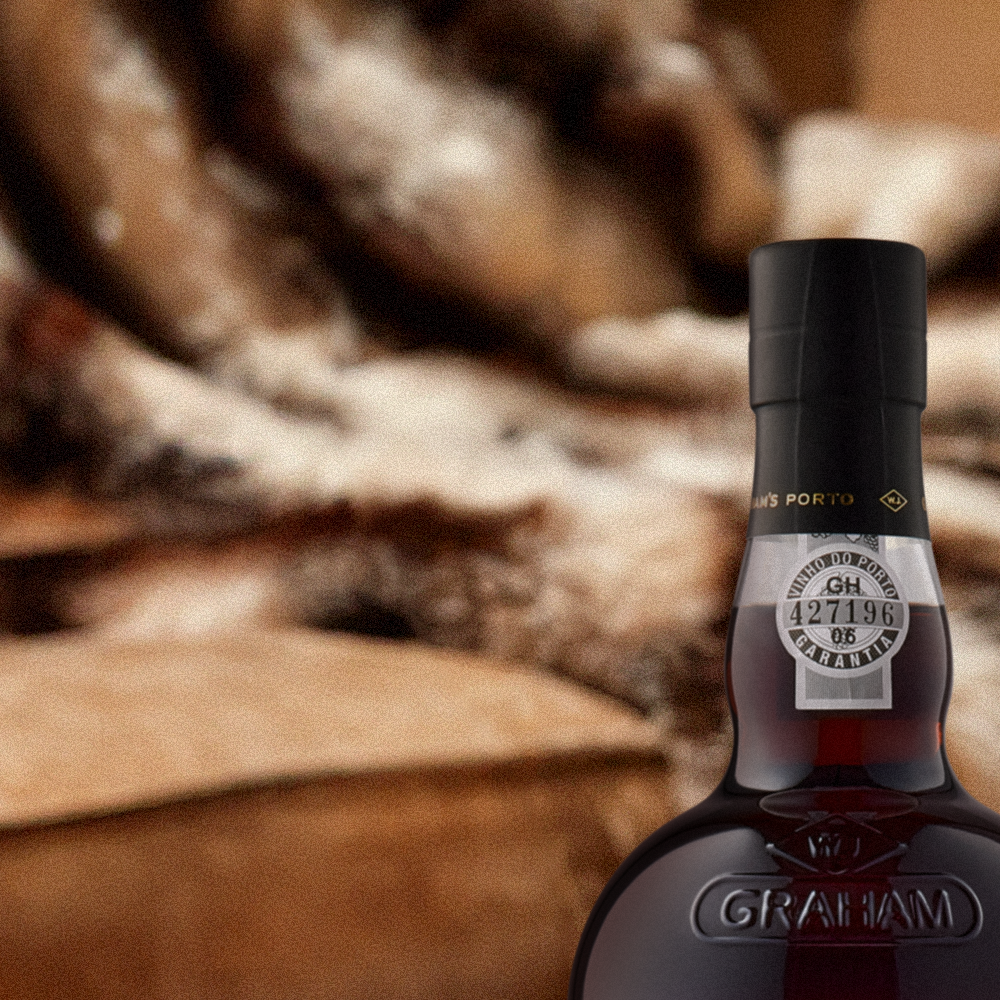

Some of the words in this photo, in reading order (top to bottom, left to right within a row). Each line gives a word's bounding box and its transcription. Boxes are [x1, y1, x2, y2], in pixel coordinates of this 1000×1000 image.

[786, 492, 854, 506] PORTO
[788, 558, 825, 598] VINHO
[831, 552, 852, 566] DO
[858, 555, 897, 597] PORTO
[826, 576, 861, 594] GH
[790, 599, 894, 626] 427196
[795, 634, 893, 669] GARANTIA
[719, 888, 953, 931] GRAHAM
